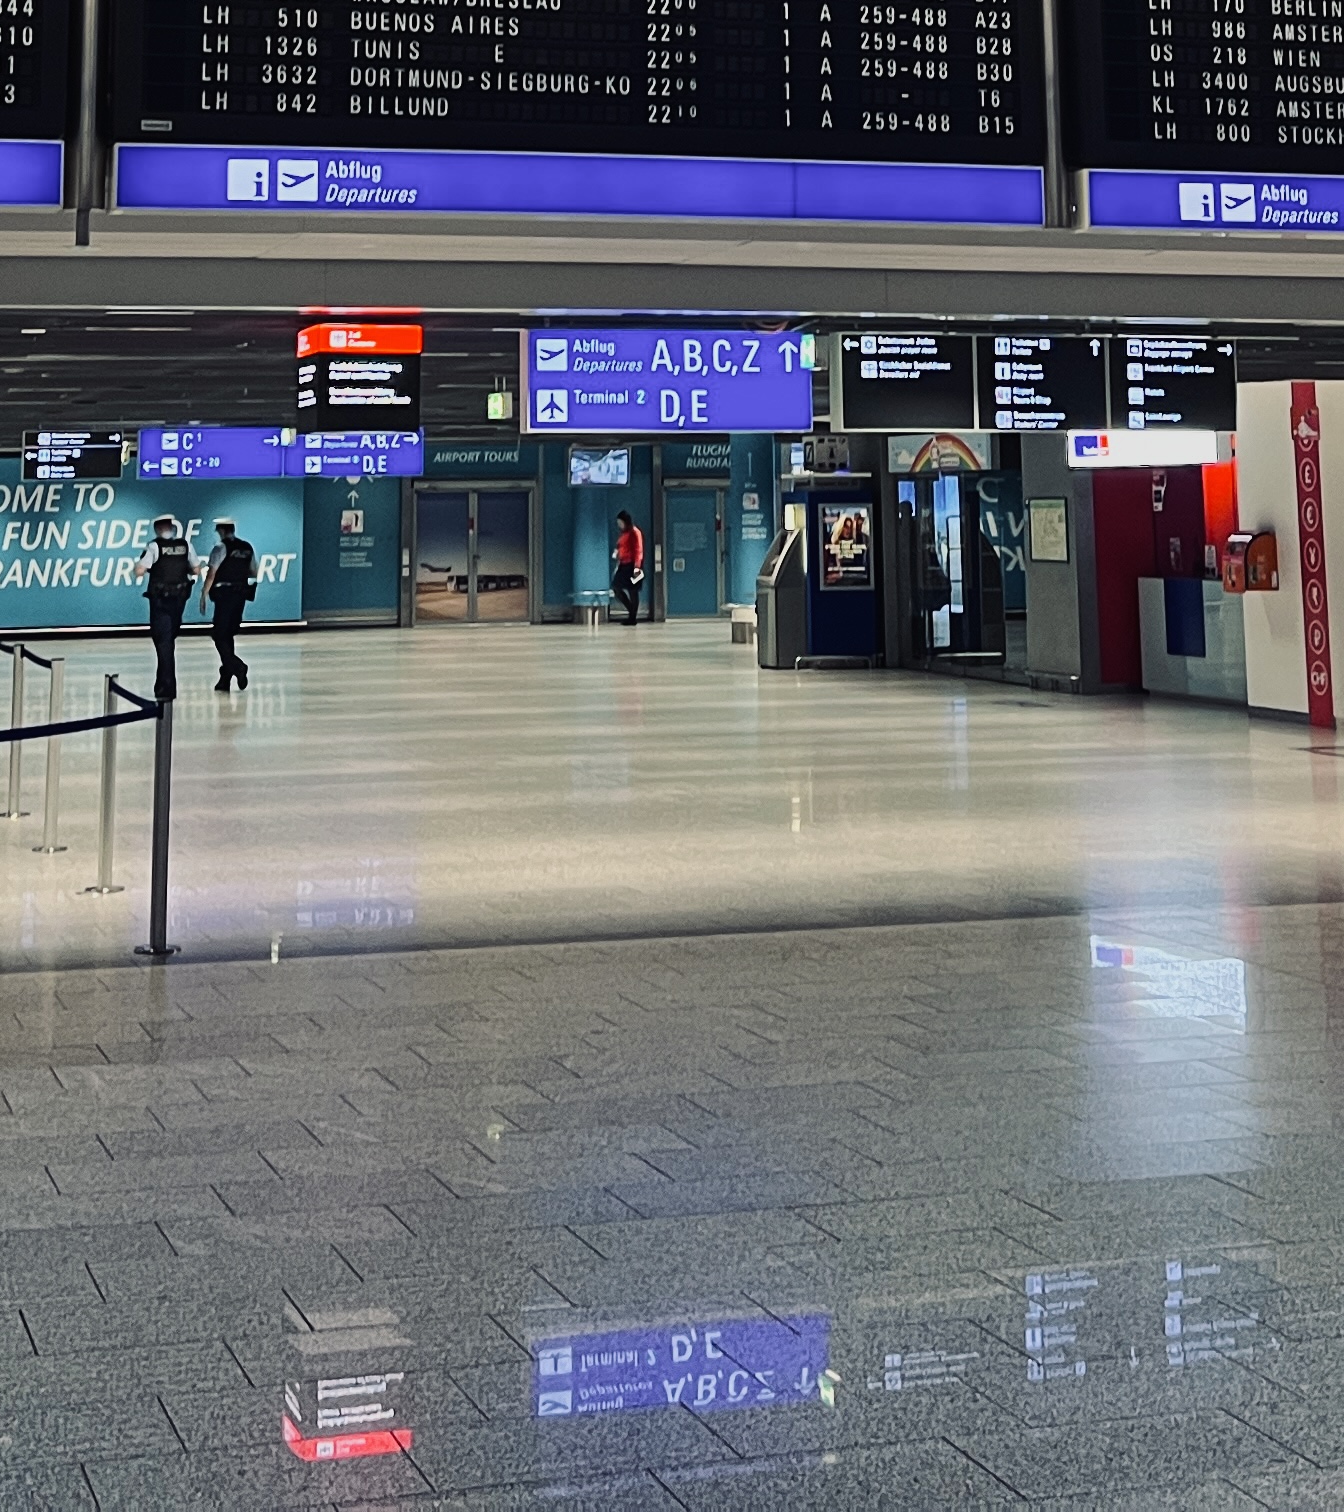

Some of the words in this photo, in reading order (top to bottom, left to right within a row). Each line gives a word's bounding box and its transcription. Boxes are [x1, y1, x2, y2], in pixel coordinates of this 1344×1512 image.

[1212, 46, 1247, 65] 218
[1272, 48, 1320, 67] WIEN
[325, 159, 382, 184] Abflug
[325, 183, 418, 207] Departures
[1260, 183, 1308, 206] Abflug
[1261, 205, 1339, 227] Departures
[572, 338, 615, 357] Abflug
[572, 356, 643, 375] Departures
[573, 389, 629, 405] Terminal
[636, 391, 646, 405] 2
[660, 389, 709, 427] D,E
[433, 451, 481, 463] AIRPORT
[483, 449, 519, 463] TOURS
[73, 483, 120, 518] TO
[1, 520, 71, 552] FUN
[78, 518, 151, 550] SIDE
